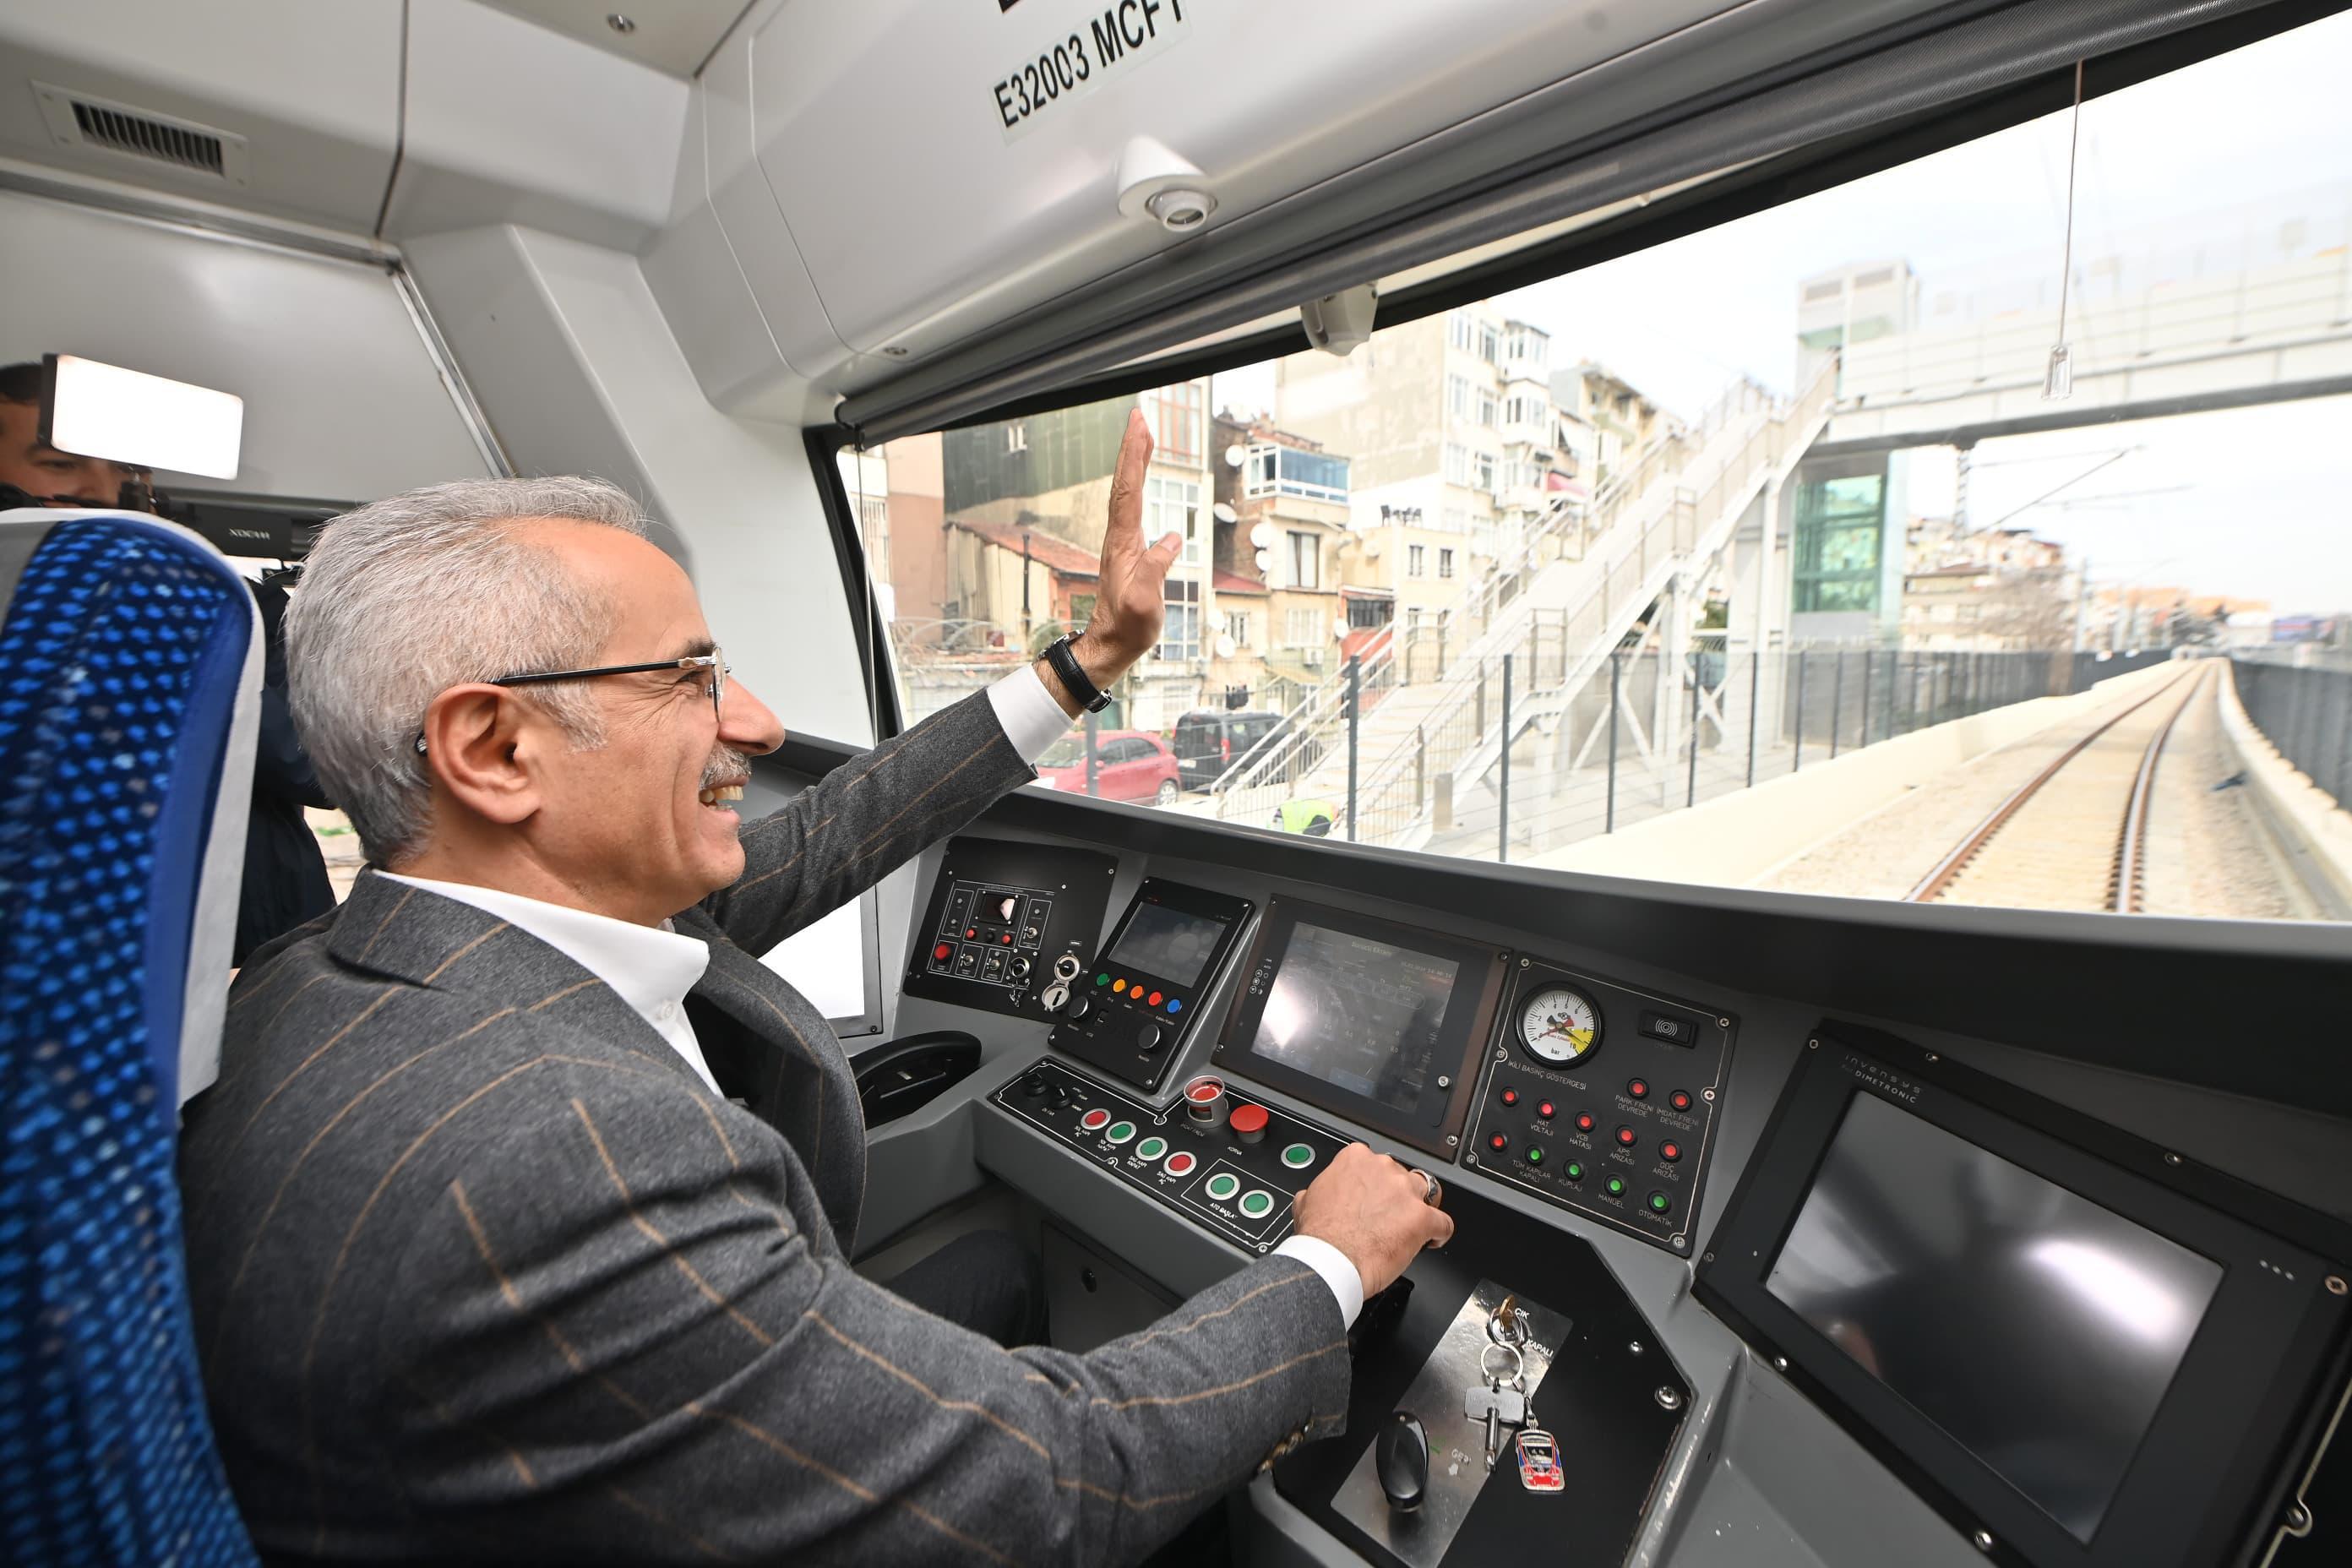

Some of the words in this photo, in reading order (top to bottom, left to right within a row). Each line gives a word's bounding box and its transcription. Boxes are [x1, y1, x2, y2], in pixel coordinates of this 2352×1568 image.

[994, 33, 1090, 128] E32003
[1854, 1070, 1917, 1103] DIMETRONIC
[1614, 1094, 1632, 1105] PARK
[1617, 1102, 1648, 1118] DEVREDE
[1537, 1118, 1550, 1127] HAT
[1659, 1116, 1693, 1131] DEVREDE
[1576, 1130, 1589, 1141] VCB
[1569, 1137, 1592, 1150] HATASI
[1609, 1151, 1635, 1166] ARIZASI
[1598, 1193, 1625, 1209] MANUEL
[1526, 1338, 1554, 1358] KAPALI
